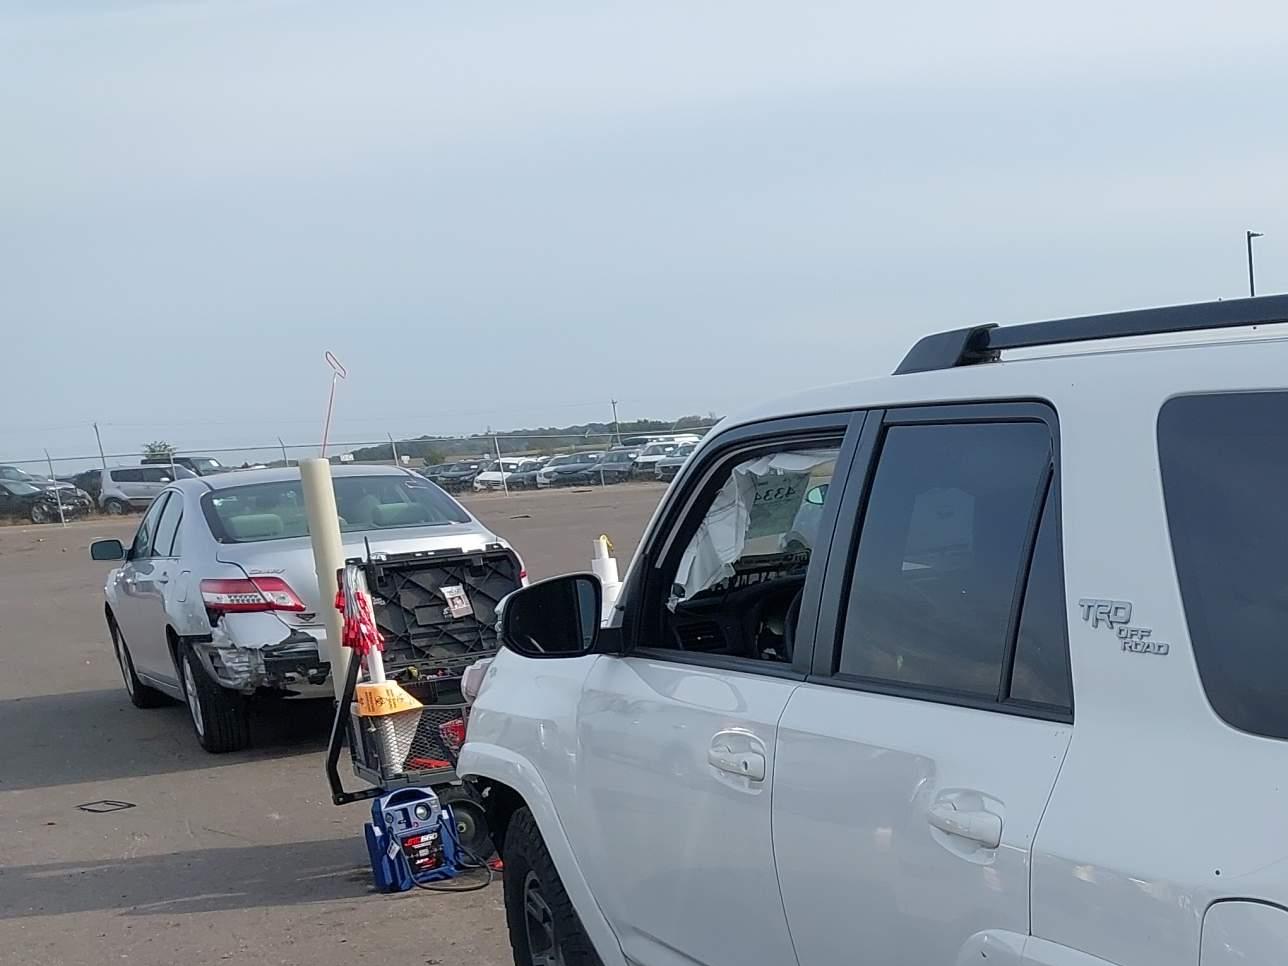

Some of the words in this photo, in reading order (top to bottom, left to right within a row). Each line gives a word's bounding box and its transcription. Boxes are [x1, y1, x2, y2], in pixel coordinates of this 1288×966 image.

[1079, 599, 1132, 630] TRD
[1117, 627, 1152, 640] OFF
[1121, 640, 1170, 656] ROAD
